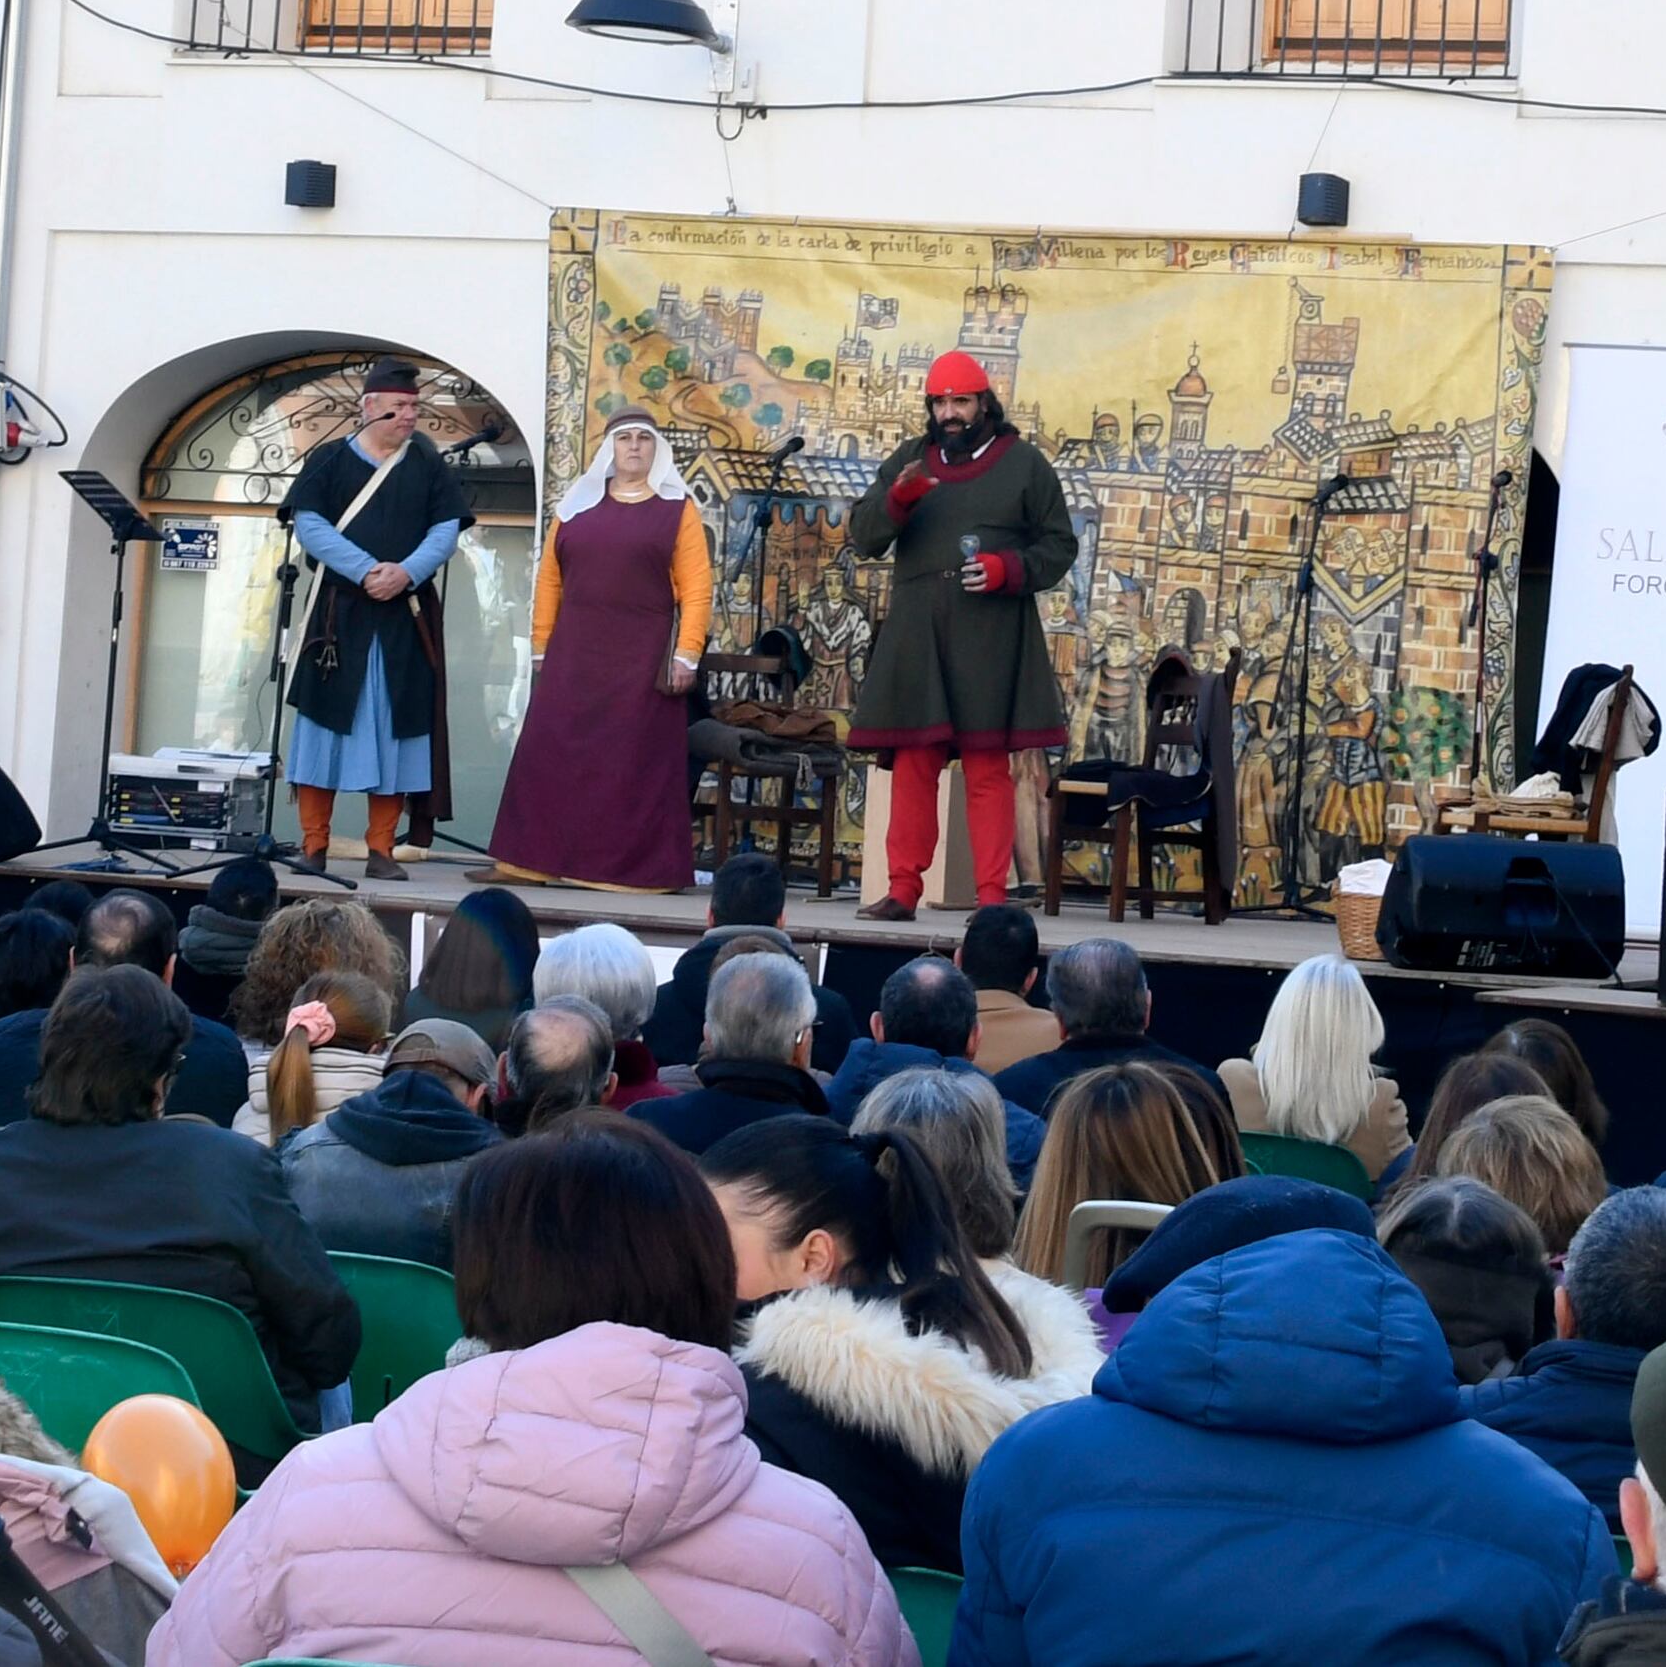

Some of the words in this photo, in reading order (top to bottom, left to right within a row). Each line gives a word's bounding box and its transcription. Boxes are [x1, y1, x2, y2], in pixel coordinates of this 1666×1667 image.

[605, 219, 642, 246] La
[757, 229, 771, 246] de
[777, 230, 792, 247] la
[798, 234, 839, 250] carta
[845, 232, 862, 251] de
[870, 235, 953, 262] privilegio
[965, 246, 977, 255] a
[1037, 236, 1106, 267] Villena
[1115, 247, 1138, 267] por
[1145, 242, 1167, 260] los
[1166, 238, 1226, 271] Reyes
[1323, 246, 1384, 271] Isabel
